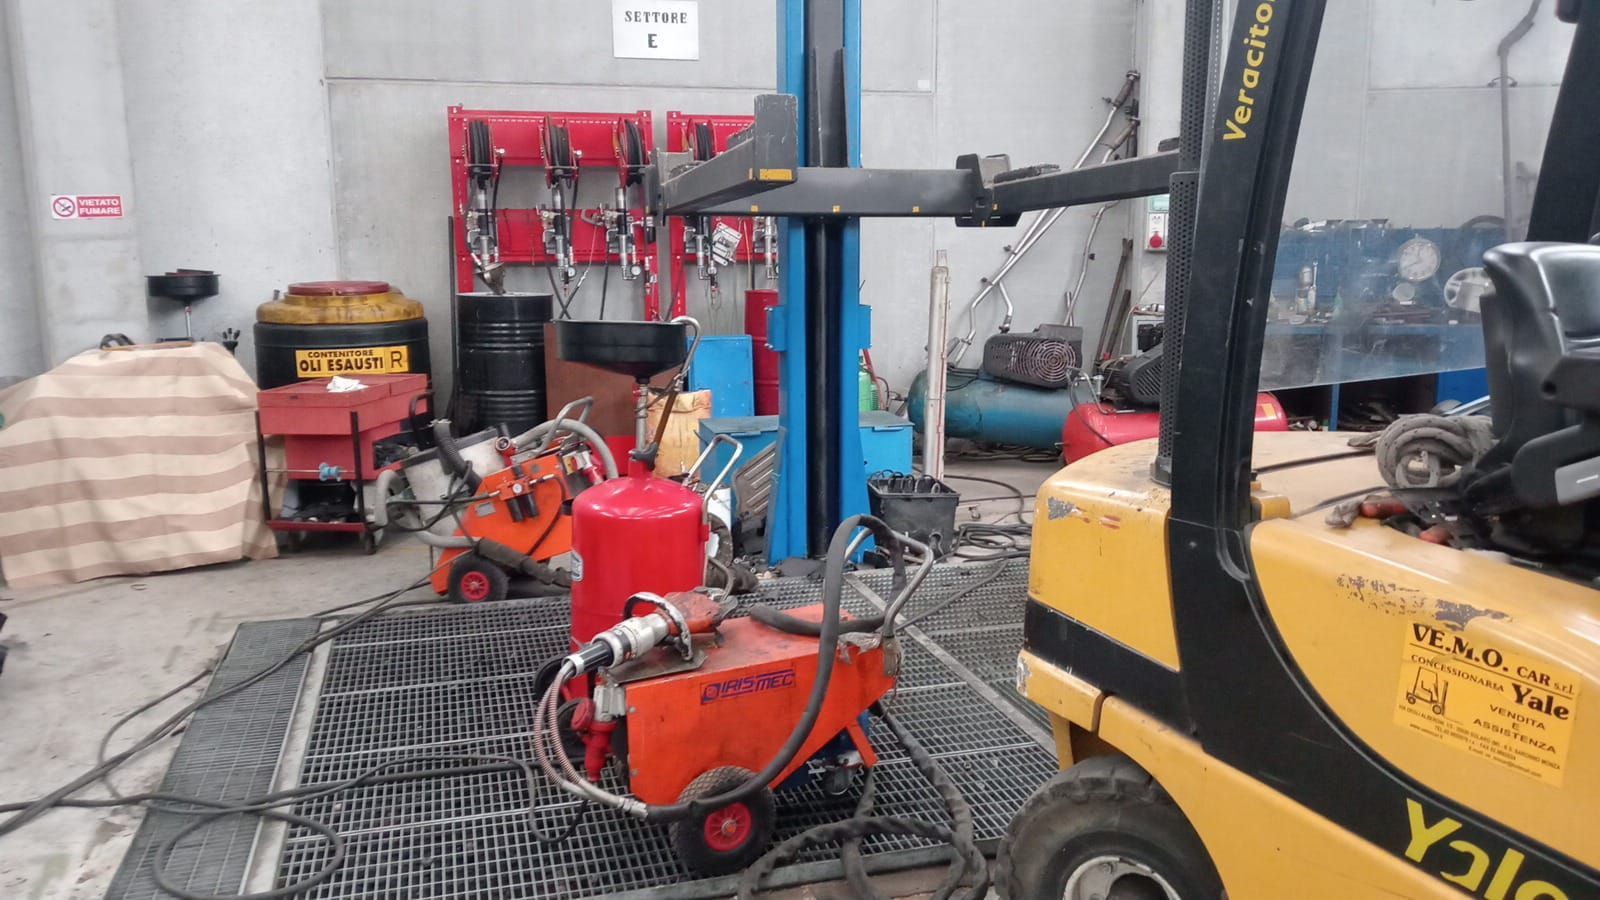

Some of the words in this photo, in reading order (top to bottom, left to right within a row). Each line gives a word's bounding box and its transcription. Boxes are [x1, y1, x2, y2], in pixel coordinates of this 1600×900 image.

[624, 10, 688, 24] SETTORE
[647, 33, 658, 48] E
[1223, 0, 1275, 140] Veracito
[80, 207, 121, 215] FUMARE
[307, 349, 374, 358] CONTENITORE
[390, 351, 403, 368] R
[299, 359, 322, 372] OLI
[327, 357, 384, 371] ESAUSTI
[1412, 623, 1509, 673] VE.M.O.
[1516, 666, 1551, 687] CAR
[1411, 654, 1505, 692] CONCESSIONARIA
[1511, 682, 1570, 720] Yale
[1489, 704, 1546, 731] VENDITA
[1512, 721, 1520, 731] E
[1473, 718, 1557, 754] ASSISTENZA
